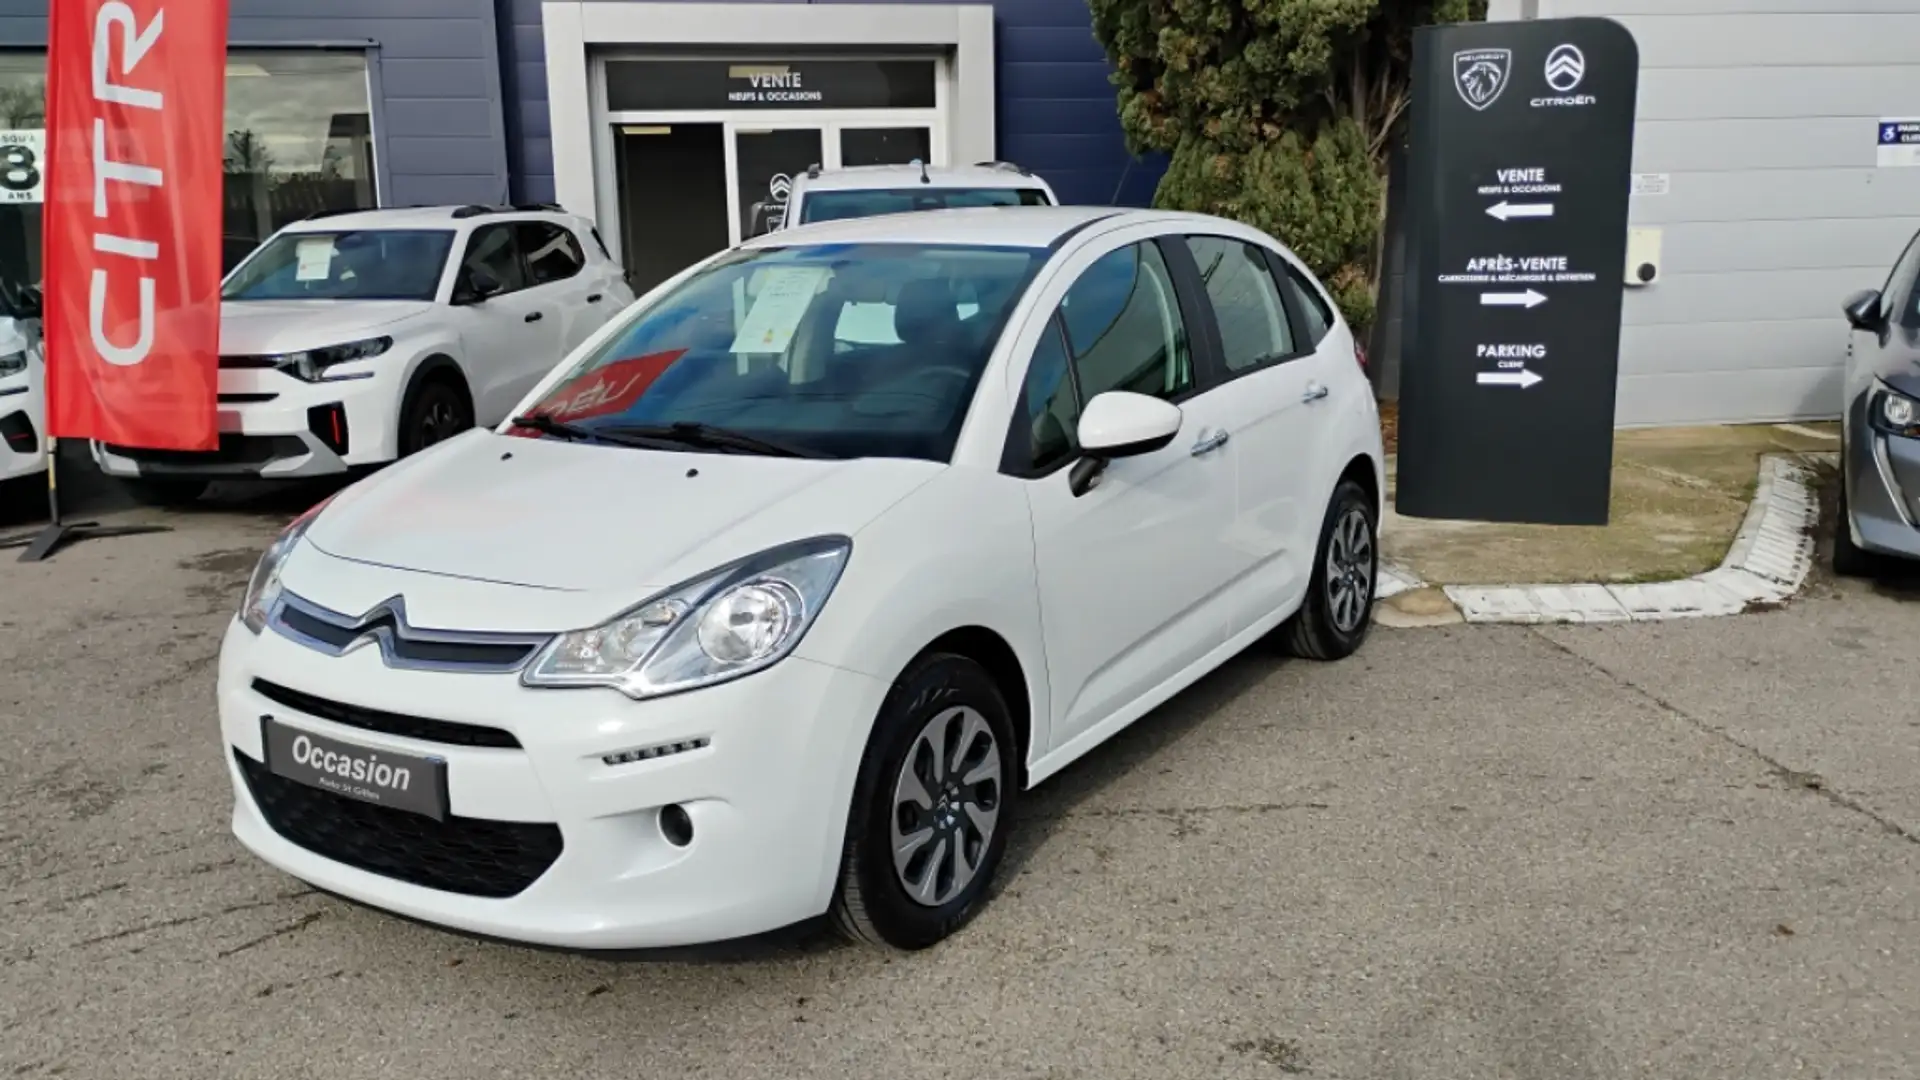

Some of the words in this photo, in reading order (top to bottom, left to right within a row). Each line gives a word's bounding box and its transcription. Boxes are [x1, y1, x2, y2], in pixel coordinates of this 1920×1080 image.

[749, 72, 802, 88] VENTE
[728, 91, 756, 101] NEUFS
[758, 91, 765, 101] &
[766, 91, 822, 101] OCCASIONS
[0, 145, 40, 191] 8
[1496, 167, 1545, 183] VENTE
[89, 1, 164, 366] CITR
[1511, 184, 1562, 193] OCCASIONS
[8, 192, 33, 200] ANS
[1466, 253, 1568, 272] APRÈS-VENTE
[1499, 273, 1546, 282] MÉCANIQUE
[1555, 273, 1597, 282] ENTRETIEN
[1476, 343, 1546, 358] PARKING
[1497, 360, 1525, 368] CLIENT
[292, 735, 411, 791] Occasion
